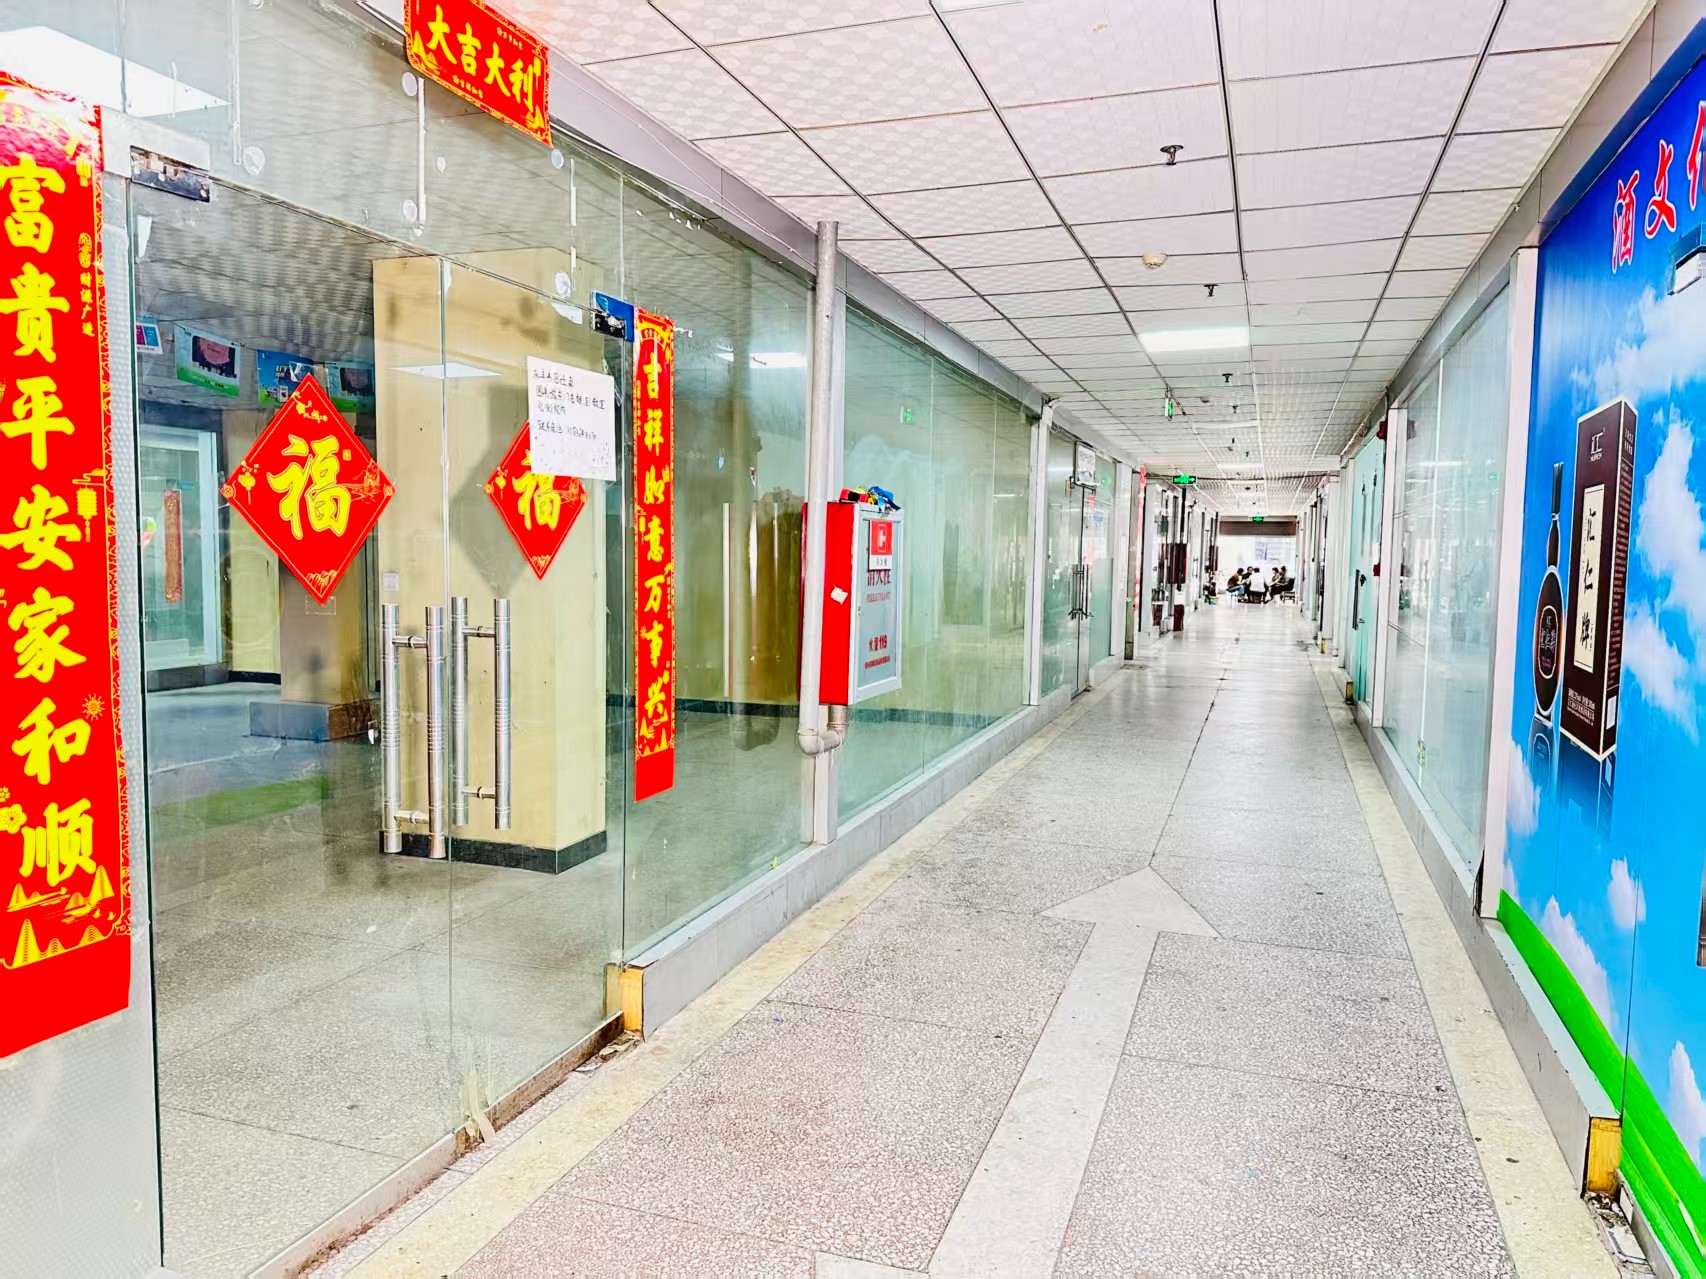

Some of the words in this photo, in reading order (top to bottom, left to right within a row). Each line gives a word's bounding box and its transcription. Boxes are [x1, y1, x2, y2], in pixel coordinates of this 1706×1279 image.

[426, 4, 535, 113] 大吉大利
[0, 153, 97, 887] 富贵平安家和顺
[266, 434, 351, 540] 福
[643, 352, 666, 719] 吉祥如意万事兴
